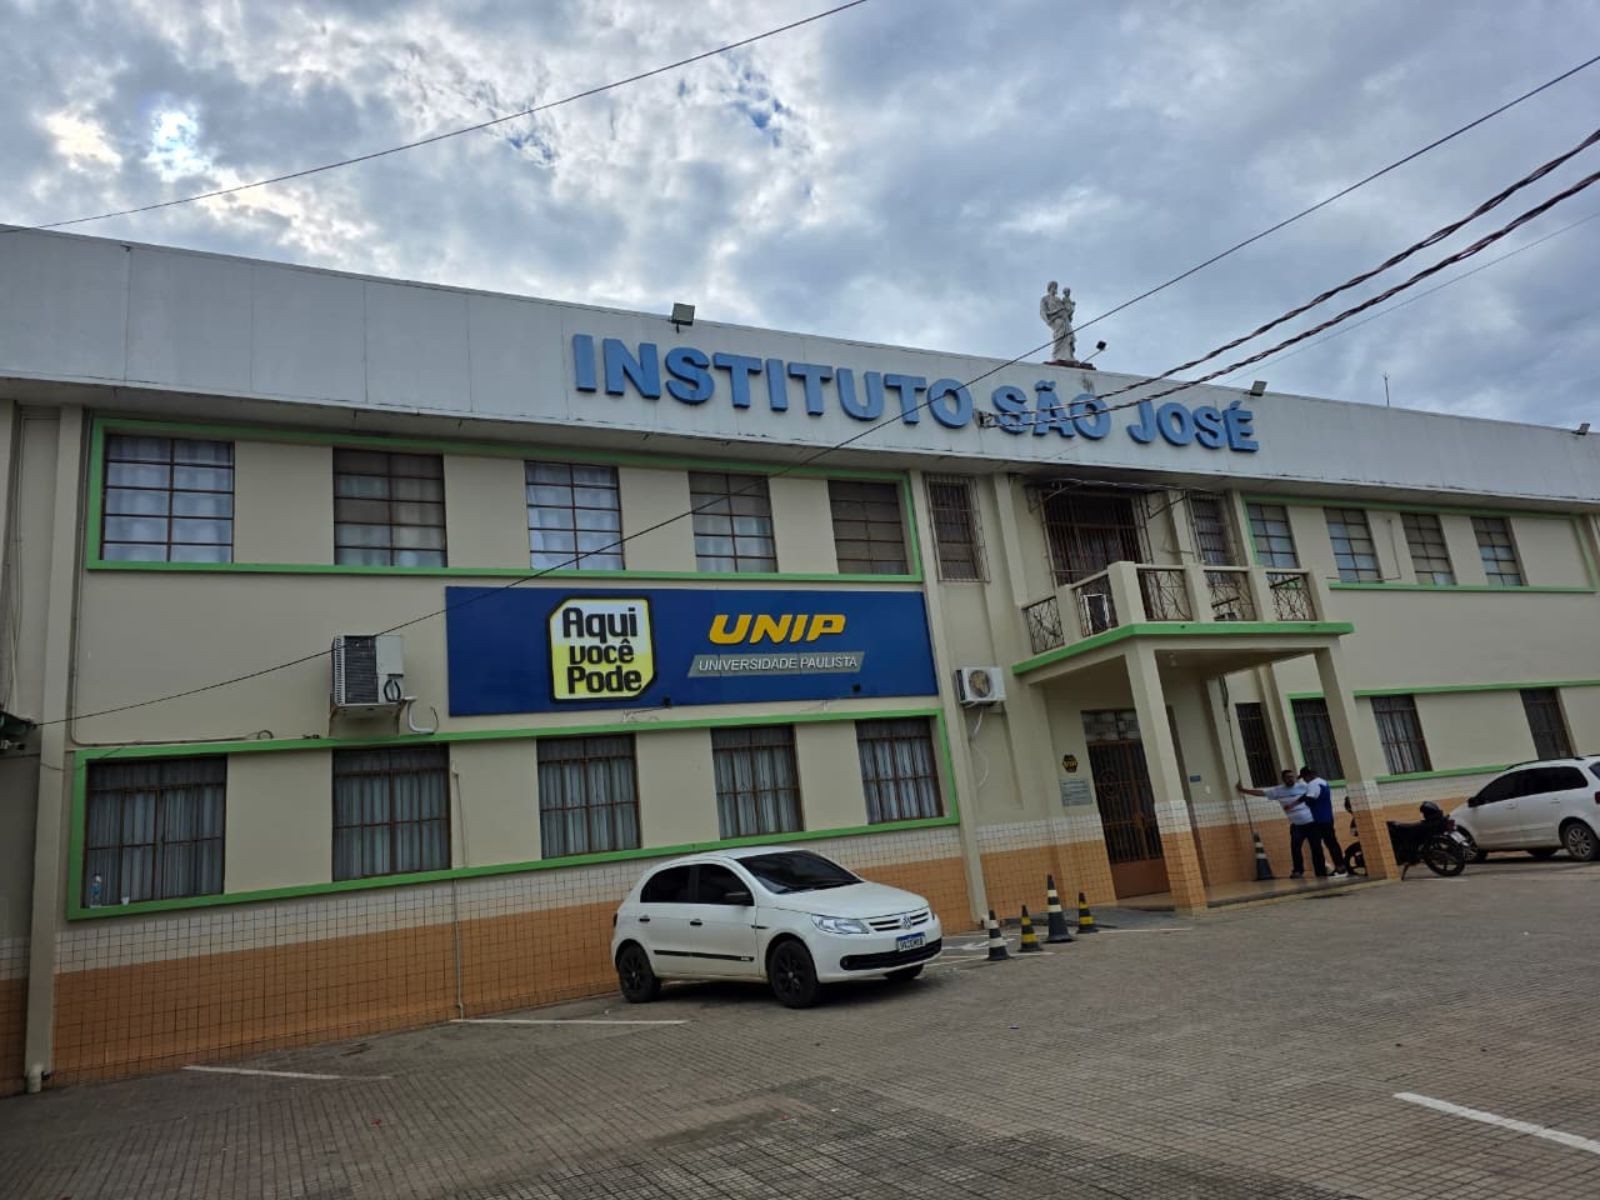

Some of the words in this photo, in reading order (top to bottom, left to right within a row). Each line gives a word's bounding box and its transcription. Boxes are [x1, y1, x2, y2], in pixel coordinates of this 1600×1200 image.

[572, 333, 974, 429] INSTITUTO
[991, 379, 1112, 440] SÃO
[1126, 399, 1259, 452] JOSÉ
[562, 606, 638, 643] Aqui
[709, 613, 847, 646] UNIP
[569, 639, 635, 664] você
[698, 657, 799, 672] UNIVERSIDADE
[800, 655, 858, 670] PAULISTA
[567, 664, 643, 695] Pode
